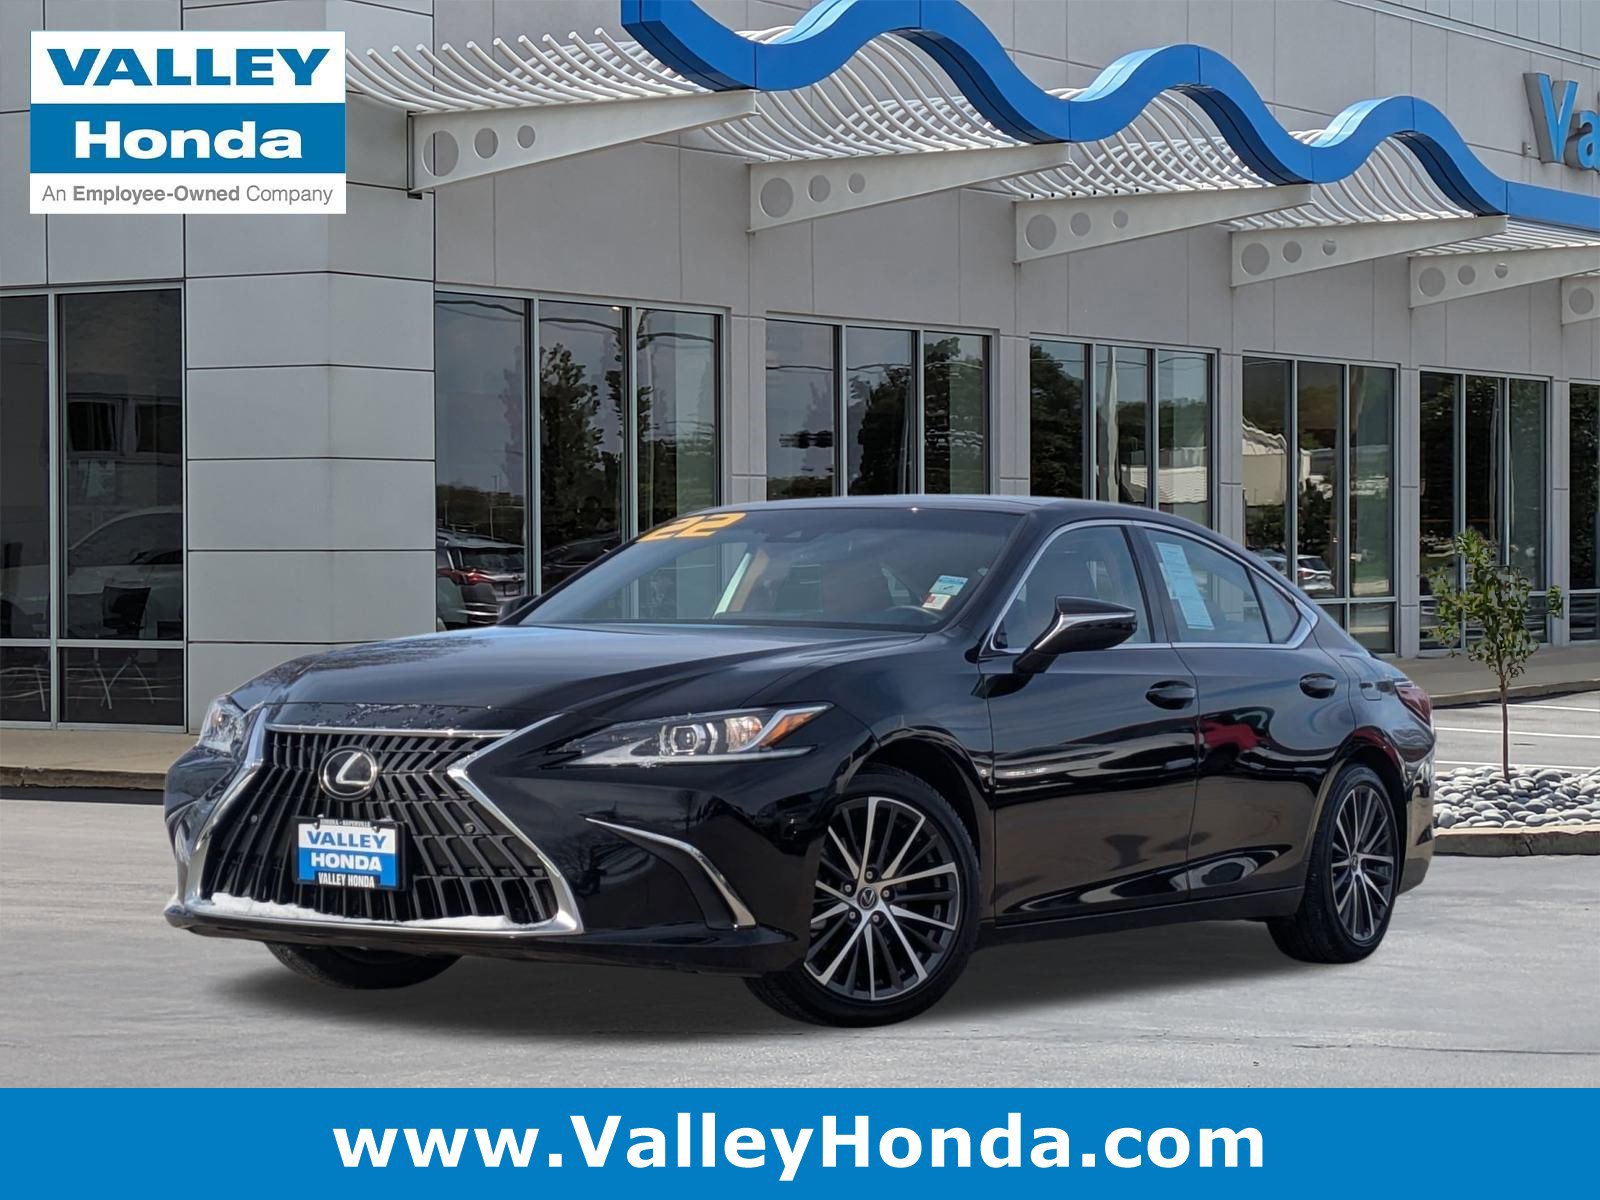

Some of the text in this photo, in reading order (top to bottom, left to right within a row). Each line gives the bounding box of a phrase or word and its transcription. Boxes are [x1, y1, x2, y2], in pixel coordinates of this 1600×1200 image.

[637, 511, 747, 542] 22
[306, 830, 387, 849] VALLEY
[311, 852, 382, 872] HONDA
[318, 871, 375, 889] VALLEY HONDA
